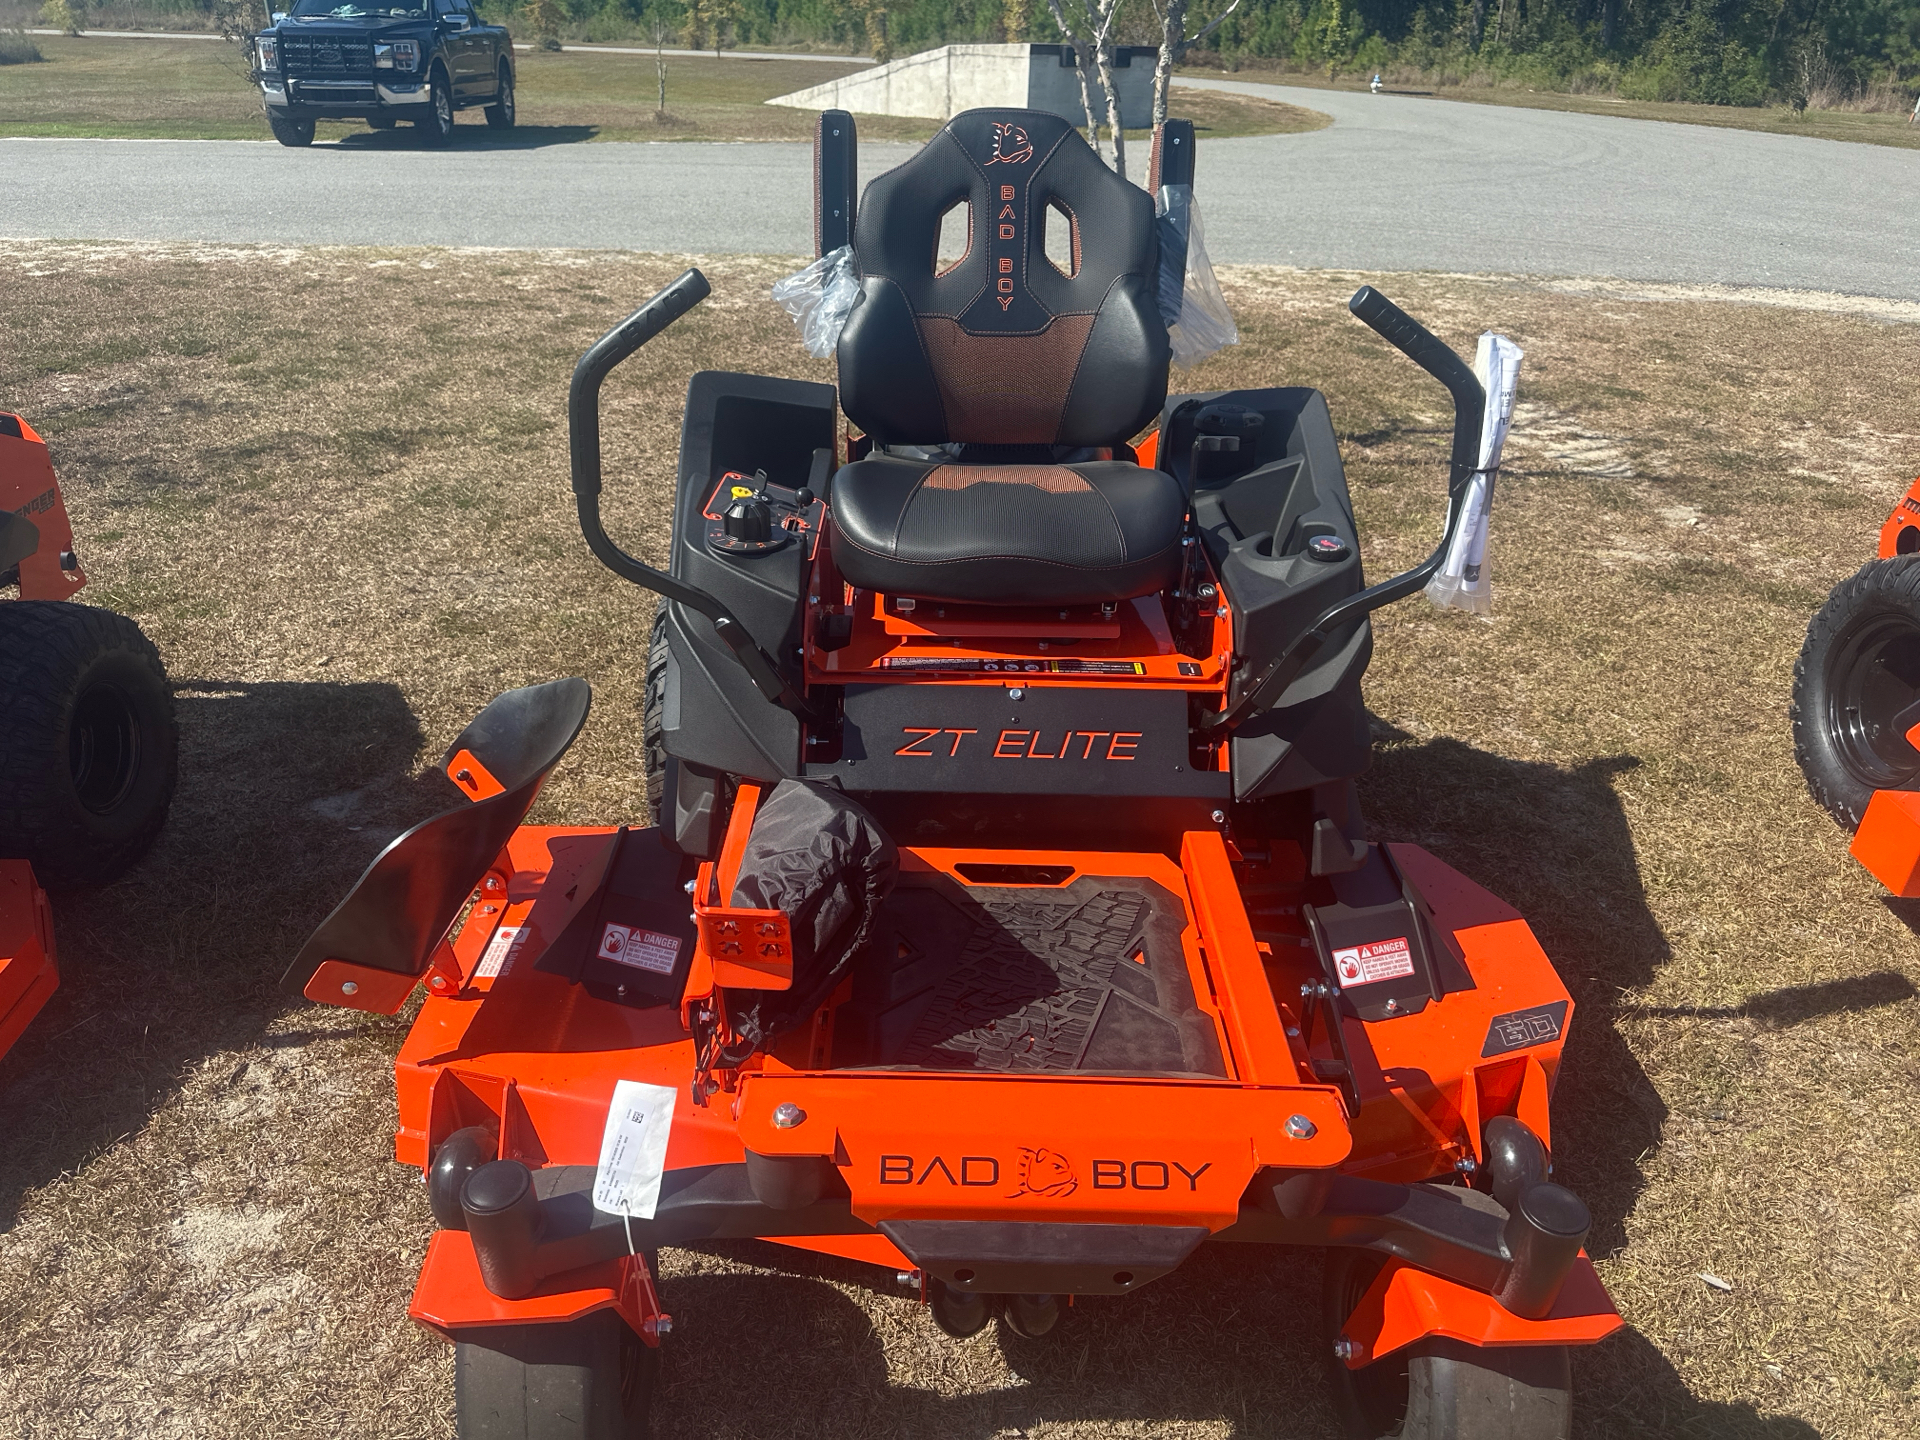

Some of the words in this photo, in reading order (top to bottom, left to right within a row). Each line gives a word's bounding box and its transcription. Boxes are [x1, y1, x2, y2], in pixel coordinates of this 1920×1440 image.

[999, 185, 1016, 239] BAD
[997, 258, 1014, 311] BOY
[619, 287, 690, 347] BAD
[1372, 303, 1440, 357] BOY
[894, 727, 978, 757] ZT
[993, 729, 1144, 761] ELITE
[644, 934, 678, 949] DANGER
[1373, 941, 1405, 954] DANGER
[500, 952, 518, 976] DANGER
[1495, 1013, 1559, 1047] 60
[879, 1155, 999, 1188] BAD
[1092, 1159, 1214, 1192] BOY
